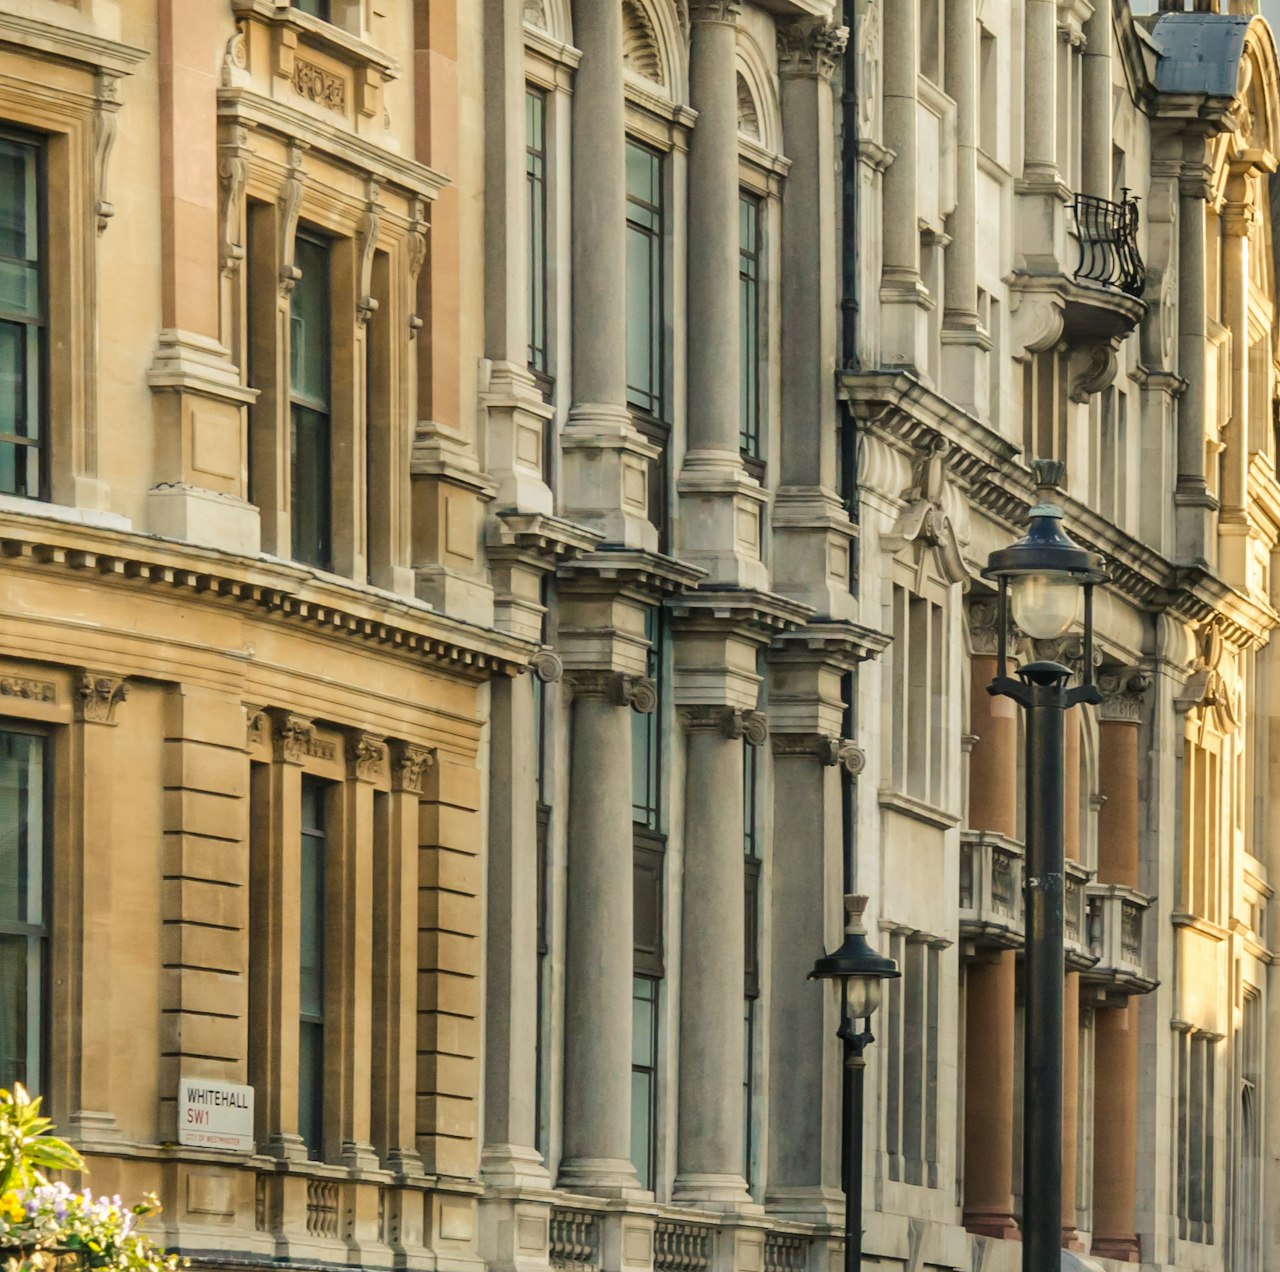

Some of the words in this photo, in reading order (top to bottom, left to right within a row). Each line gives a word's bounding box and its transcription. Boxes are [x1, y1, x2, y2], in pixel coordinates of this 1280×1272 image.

[187, 1088, 249, 1109] WHITEHALL
[187, 1108, 209, 1125] SW1
[186, 1133, 198, 1141] CITY
[198, 1134, 205, 1142] OF
[206, 1135, 240, 1146] WESTMINSTER
